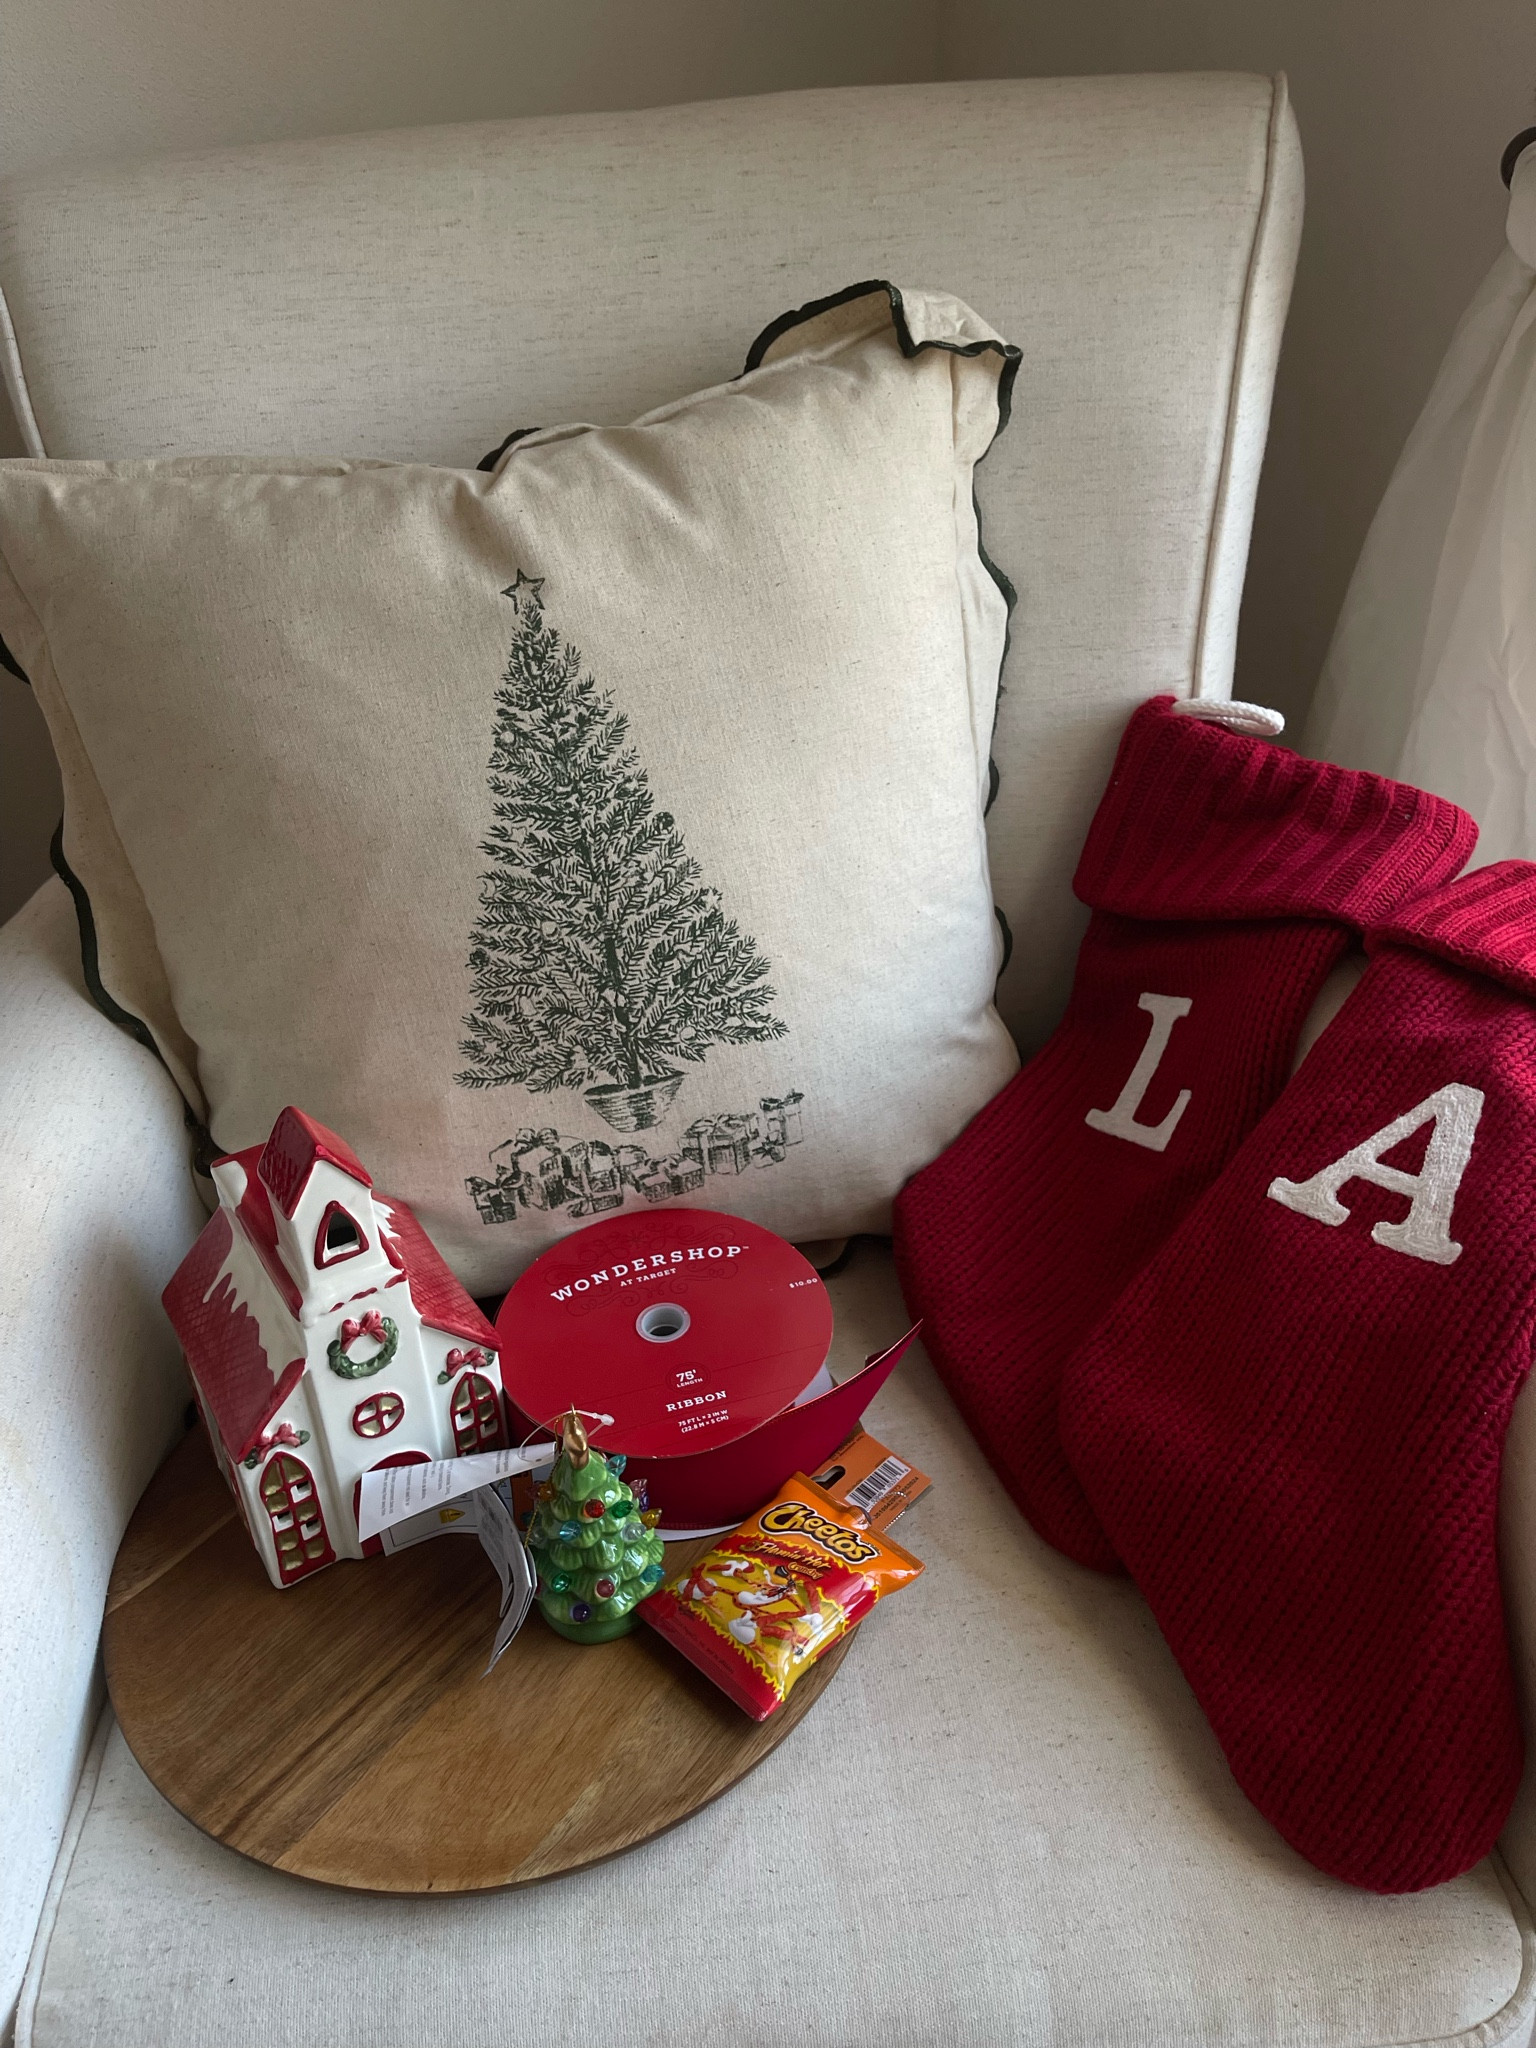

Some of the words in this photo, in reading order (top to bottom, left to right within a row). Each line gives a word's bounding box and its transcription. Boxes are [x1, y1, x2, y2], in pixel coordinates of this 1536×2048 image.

[1085, 992, 1193, 1152] L
[1267, 1082, 1485, 1265] A
[550, 1246, 742, 1301] WONDERSHOP
[620, 1279, 633, 1287] AT
[636, 1268, 677, 1283] TARGET
[789, 1278, 818, 1289] $10.00
[676, 1378, 703, 1388] LENGTH
[665, 1390, 727, 1412] RIBBON
[716, 1415, 729, 1423] CM)
[761, 1502, 876, 1562] Cheetos
[787, 1562, 823, 1580] Crunchy
[803, 1555, 831, 1569] Hot
